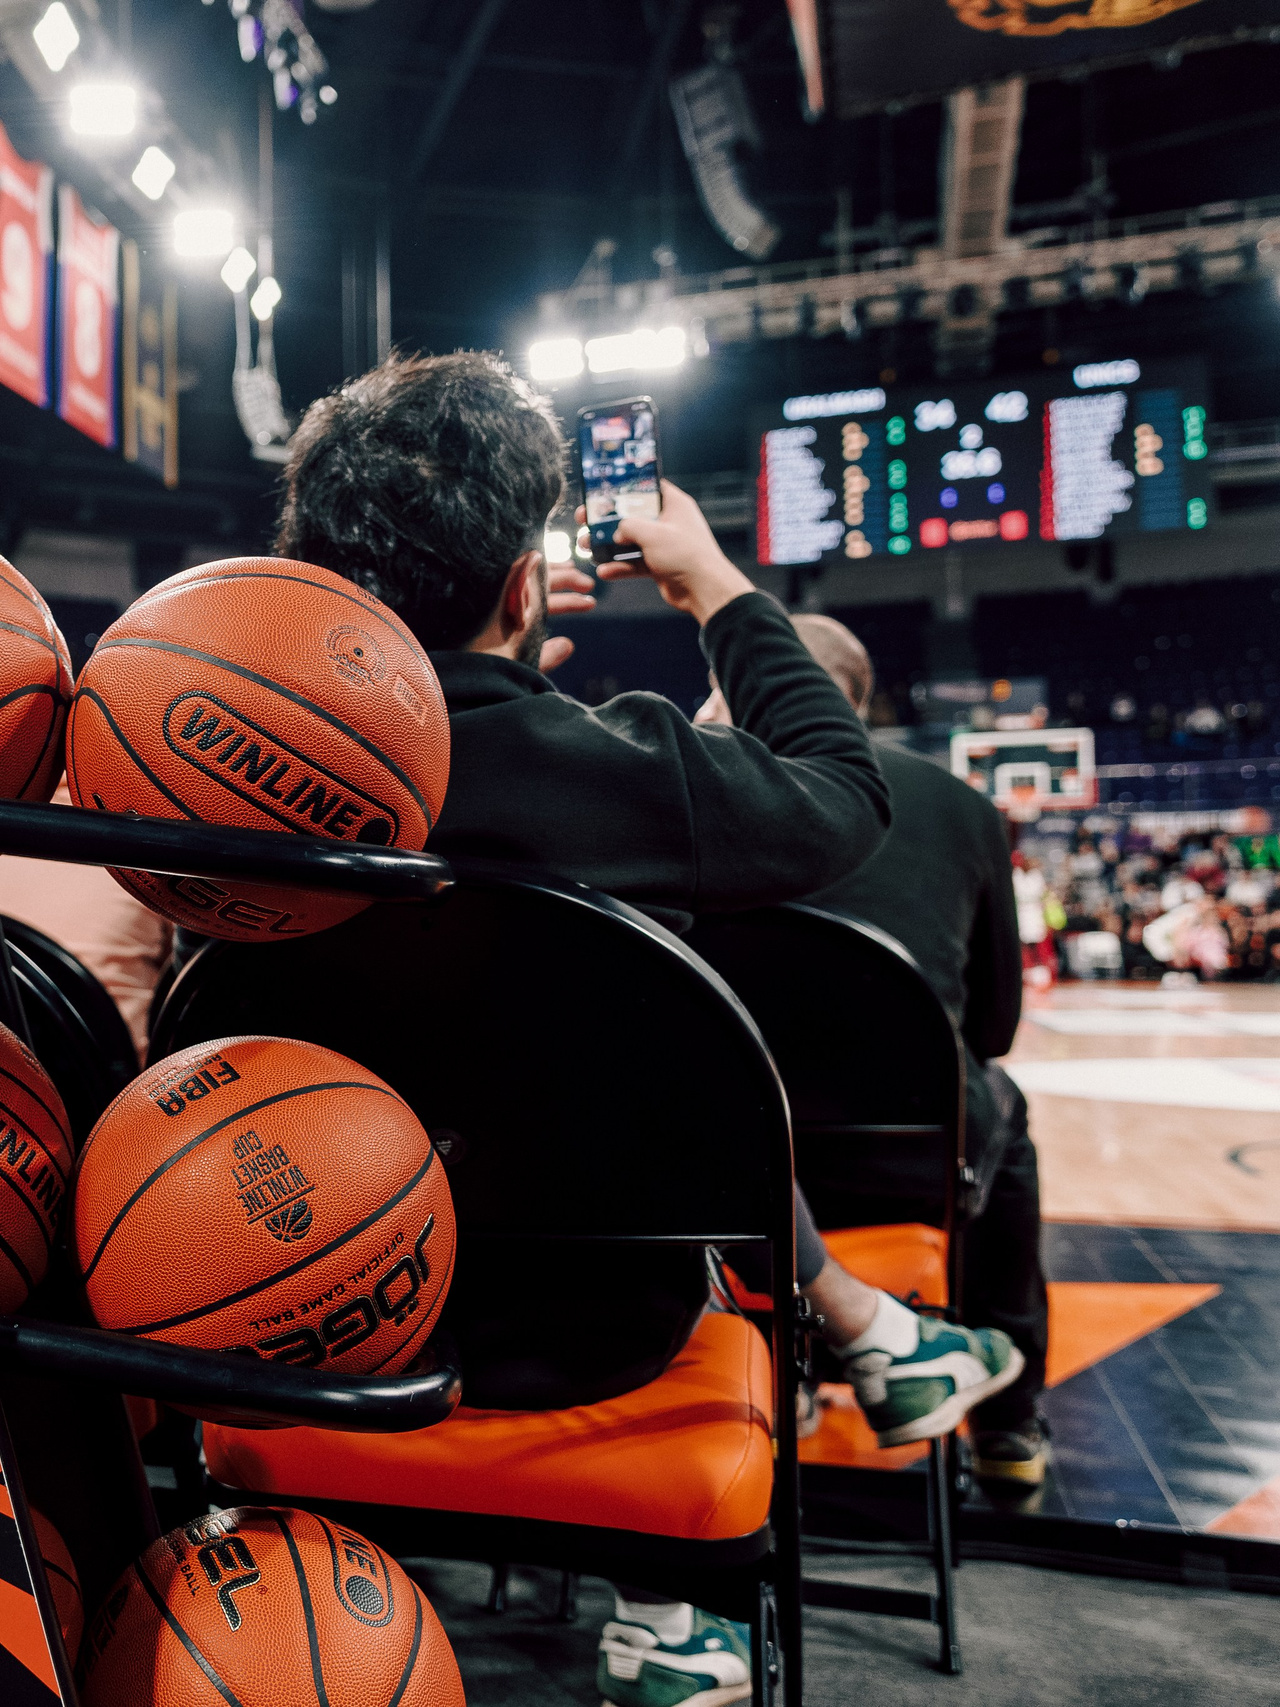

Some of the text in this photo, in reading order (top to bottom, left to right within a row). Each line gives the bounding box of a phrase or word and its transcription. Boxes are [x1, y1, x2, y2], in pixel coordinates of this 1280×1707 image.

[180, 707, 363, 838] WINLINE
[156, 1061, 241, 1117] FIBA
[231, 1144, 291, 1190] BASKET
[233, 1131, 263, 1160] CUP
[237, 1165, 309, 1217] WINLINE
[248, 1232, 404, 1331] OFFICIAL GAME BALL
[180, 1564, 200, 1597] BALL
